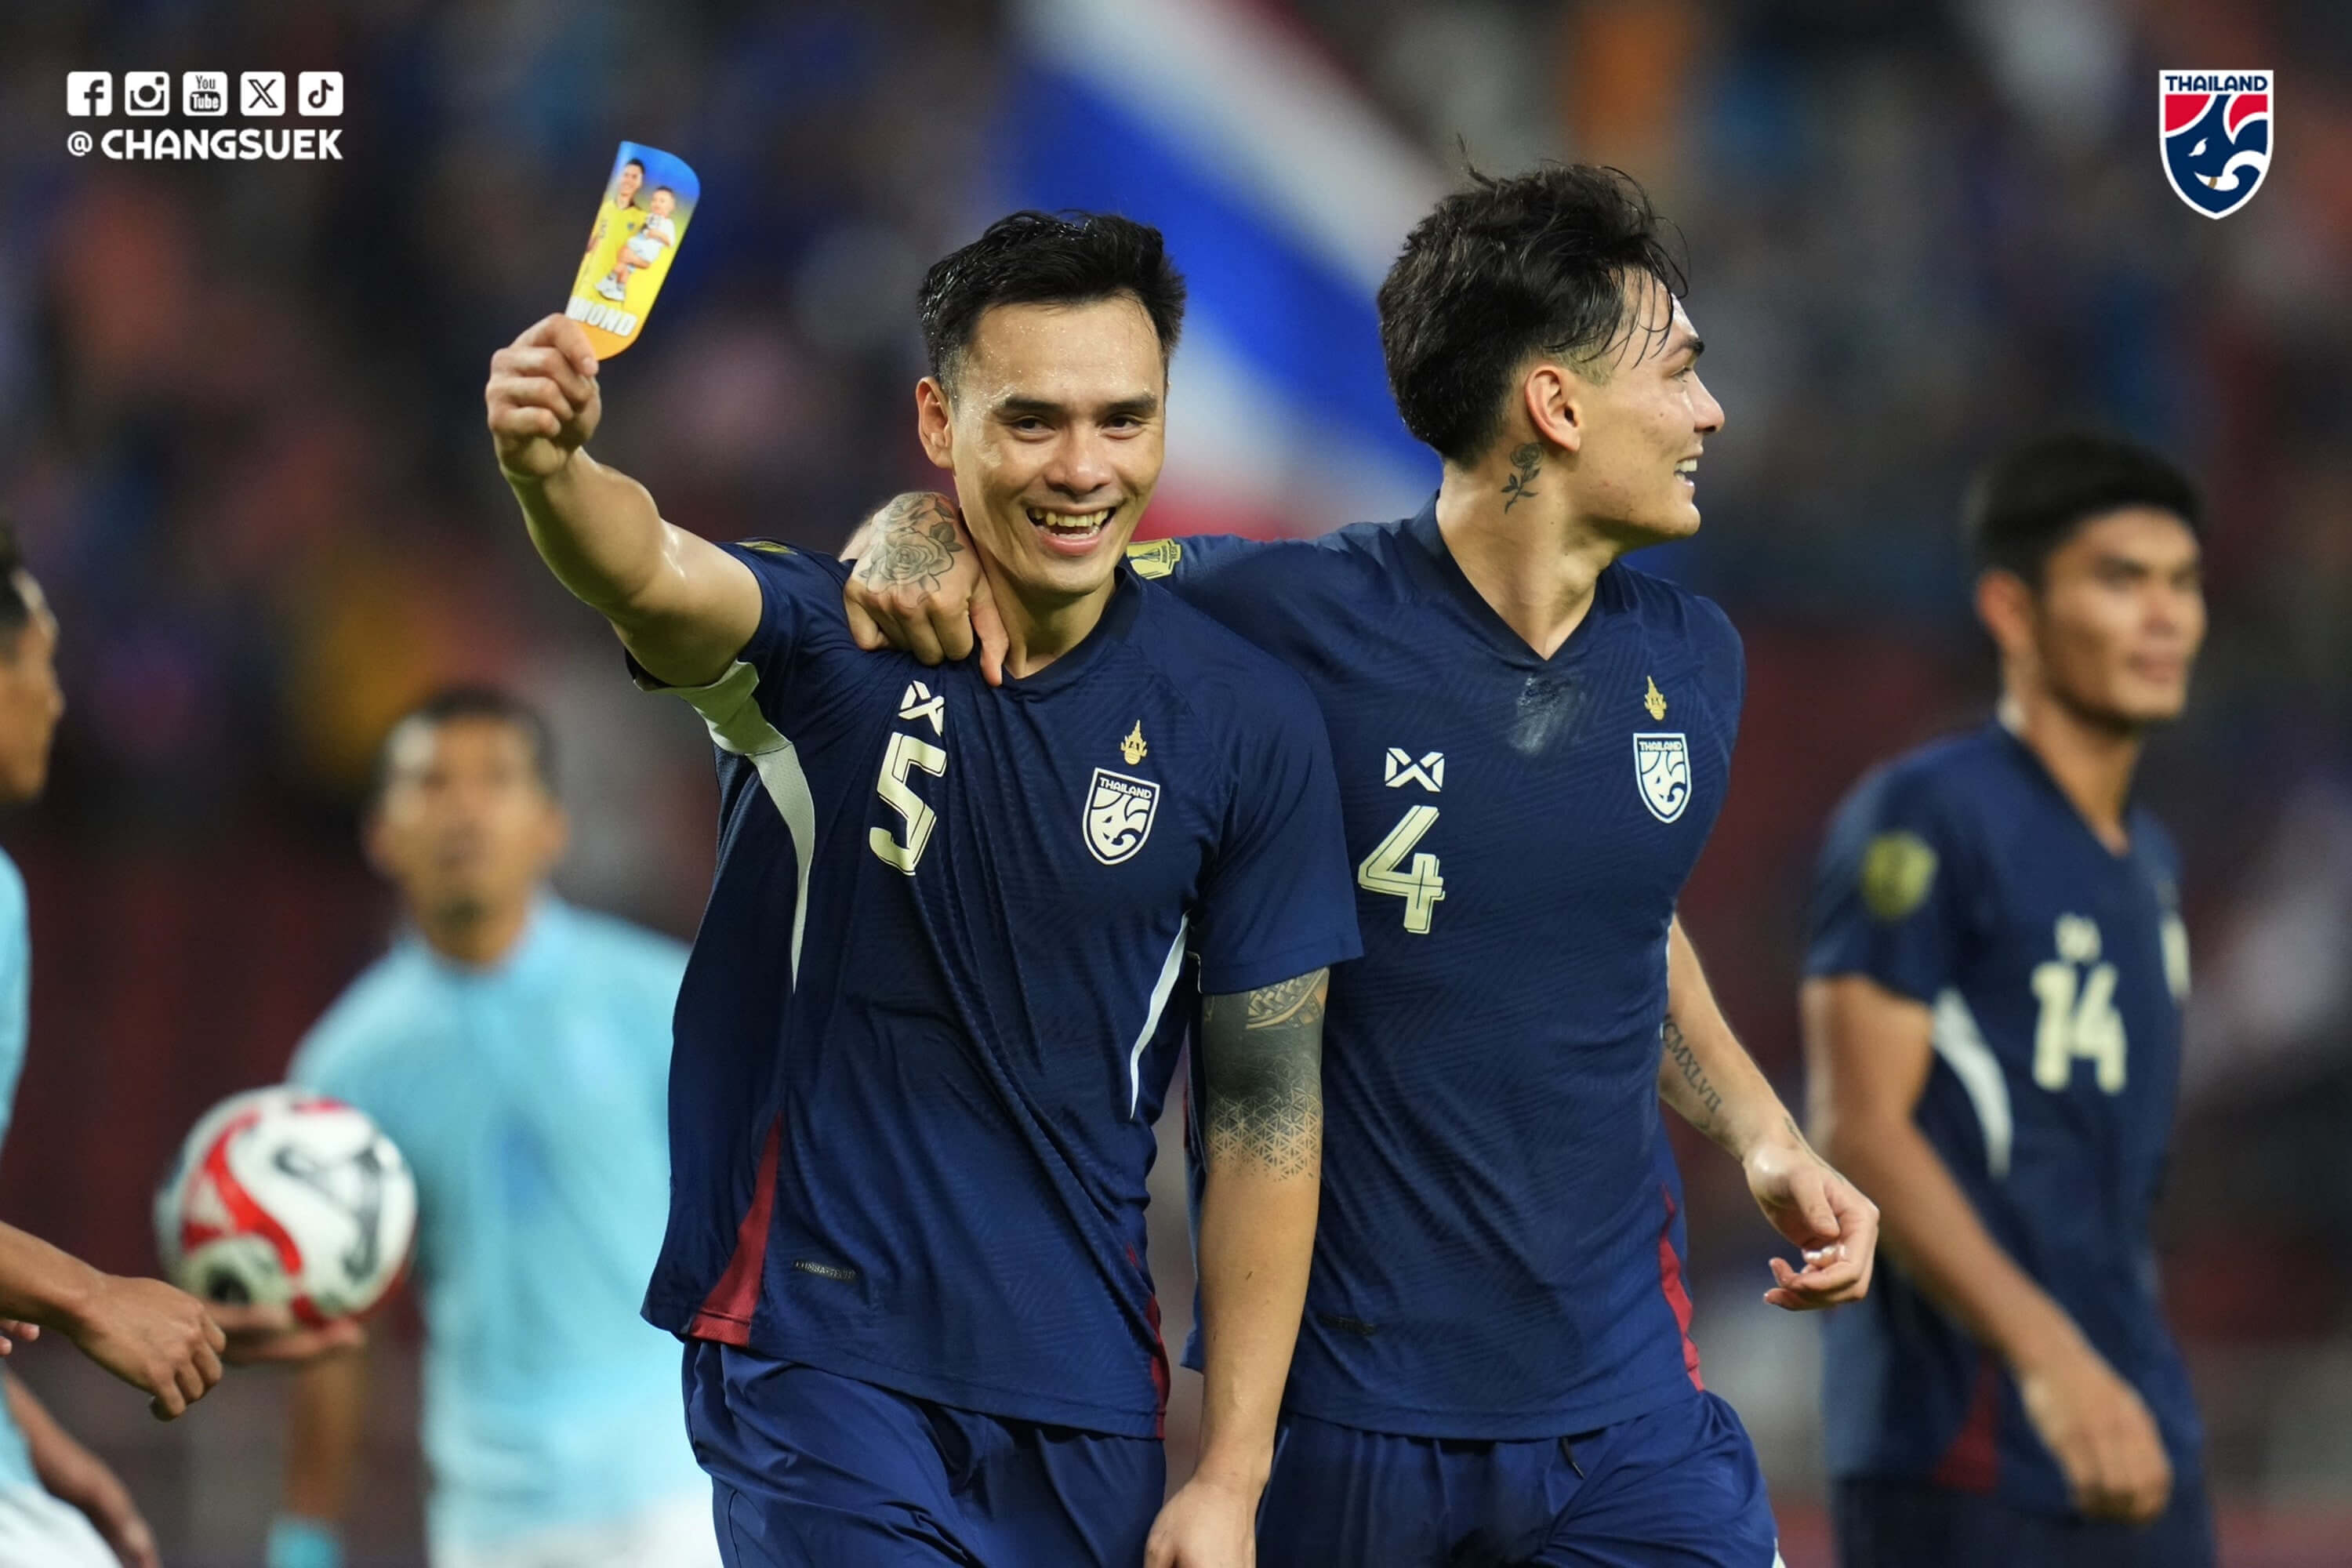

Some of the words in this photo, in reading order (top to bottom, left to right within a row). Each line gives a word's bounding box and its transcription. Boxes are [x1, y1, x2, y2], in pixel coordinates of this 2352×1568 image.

[869, 731, 947, 877] 5
[1099, 776, 1152, 800] THAILAND
[1639, 741, 1682, 752] THAILAND
[1358, 804, 1446, 935] 4
[2030, 960, 2128, 1094] 14
